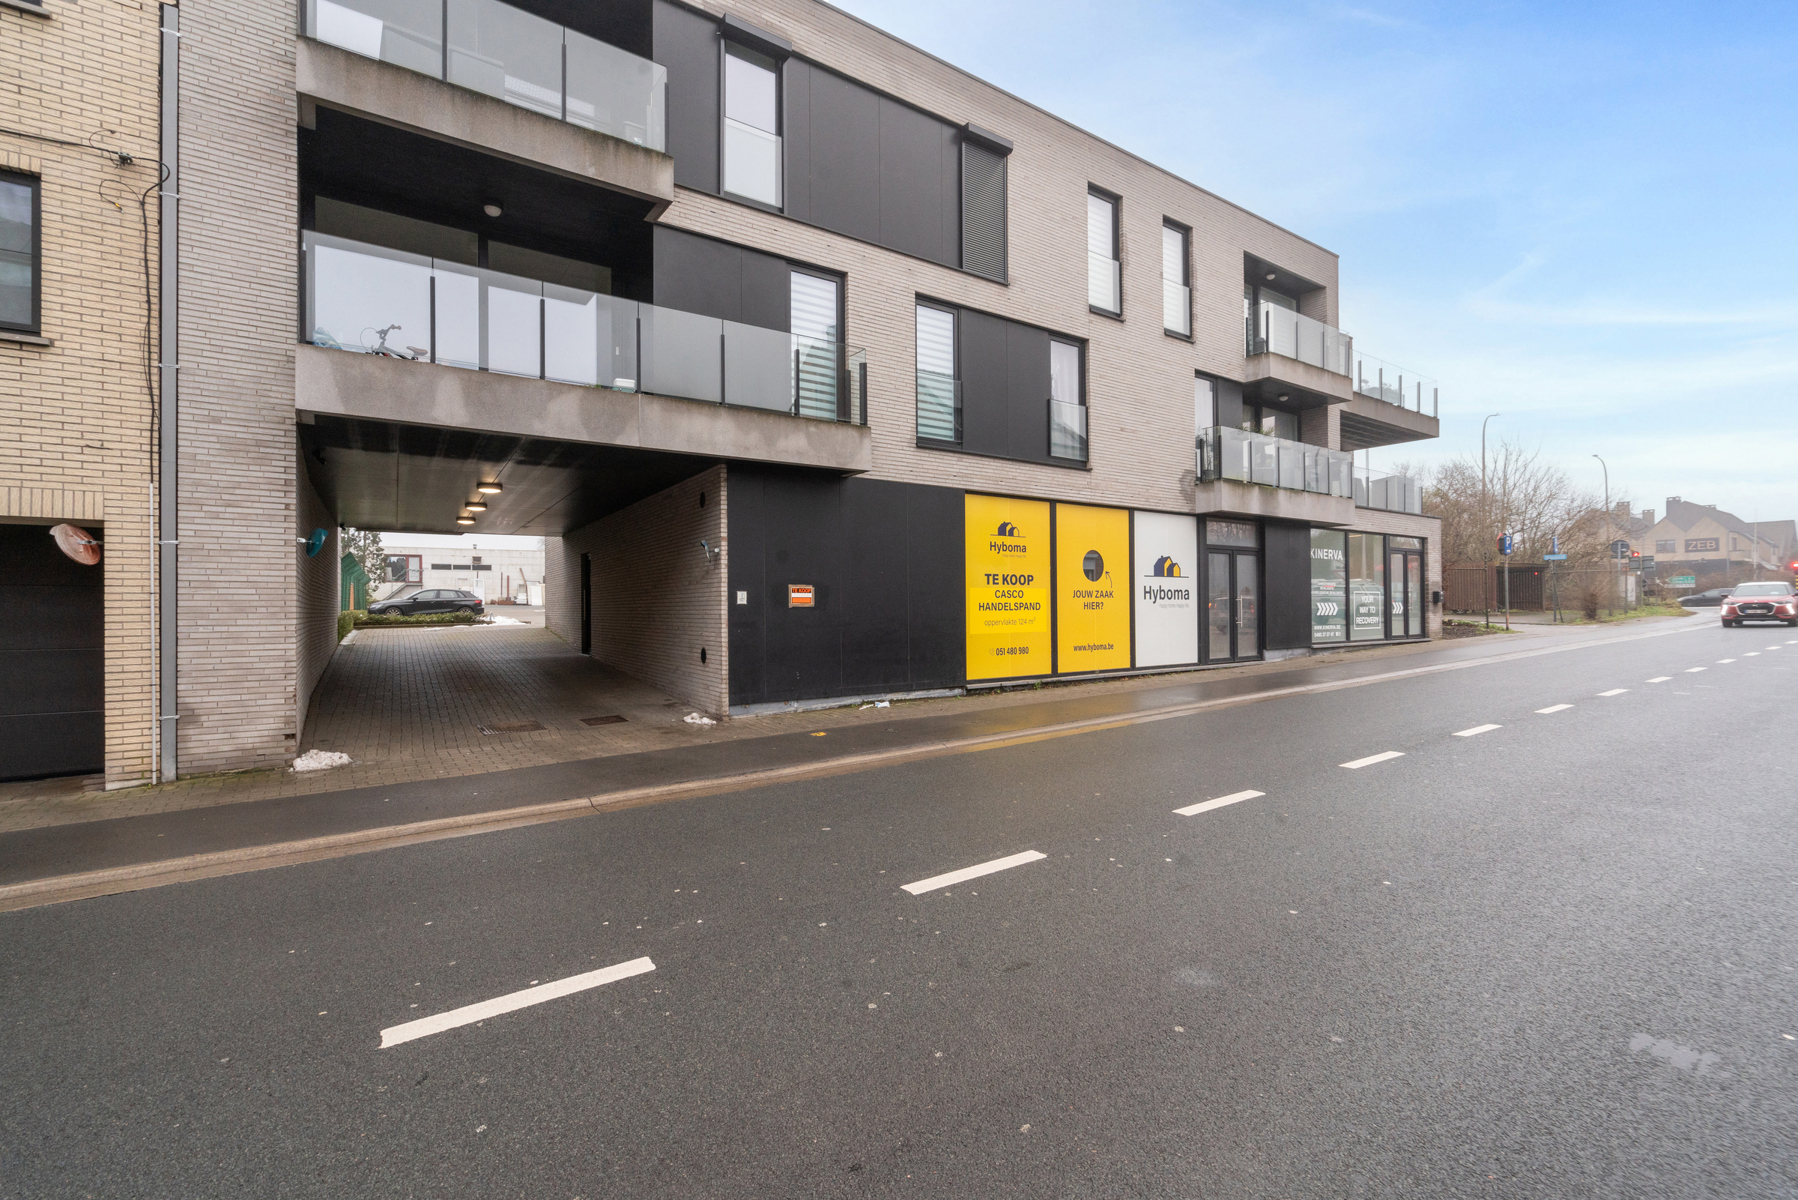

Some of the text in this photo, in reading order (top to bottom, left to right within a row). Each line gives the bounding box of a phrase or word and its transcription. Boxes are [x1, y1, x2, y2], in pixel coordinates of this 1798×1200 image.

[1506, 537, 1510, 547] P
[1688, 540, 1716, 550] ZEB
[990, 541, 1026, 554] Hyboma
[1310, 548, 1342, 560] KINERVA
[984, 574, 1034, 586] TE KOOP
[994, 590, 1024, 598] CASCO
[1072, 590, 1114, 598] JOUW ZAAK
[1144, 585, 1190, 604] Hyboma
[978, 602, 1041, 611] HANDELSPAND
[1084, 602, 1104, 610] HIER?
[984, 618, 1017, 627] oppervlakte
[996, 648, 1006, 656] 051
[1006, 647, 1018, 656] 480
[1073, 642, 1114, 652] www.hyboma.be
